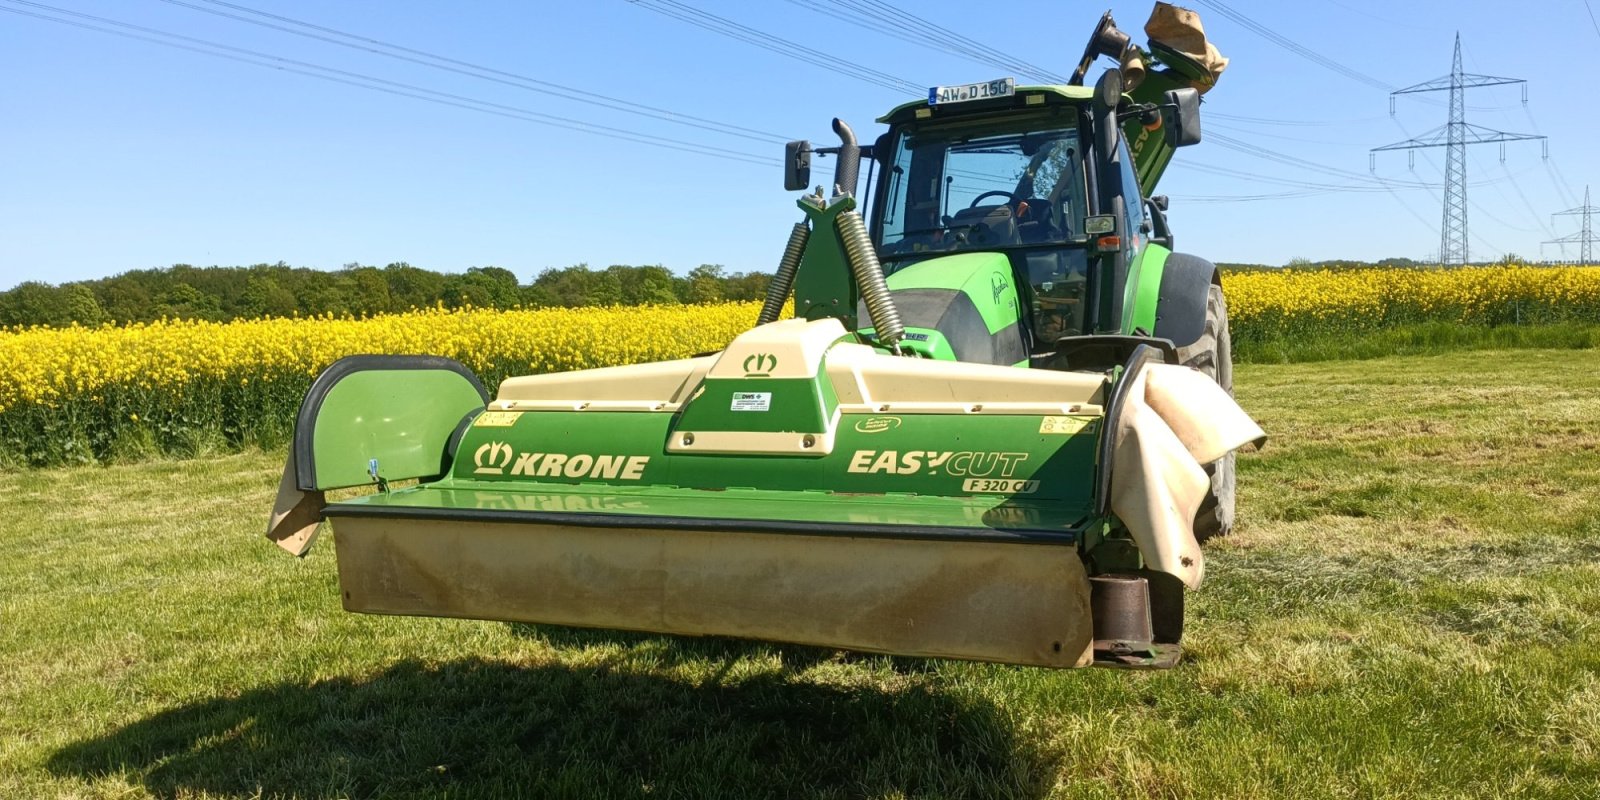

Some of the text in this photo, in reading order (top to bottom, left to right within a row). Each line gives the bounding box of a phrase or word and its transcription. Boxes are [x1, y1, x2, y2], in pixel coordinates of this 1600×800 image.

[941, 80, 1008, 102] AW D 150
[511, 453, 650, 480] KRONE
[847, 450, 1029, 477] EASYCUT
[969, 479, 1034, 492] F 320 CV
